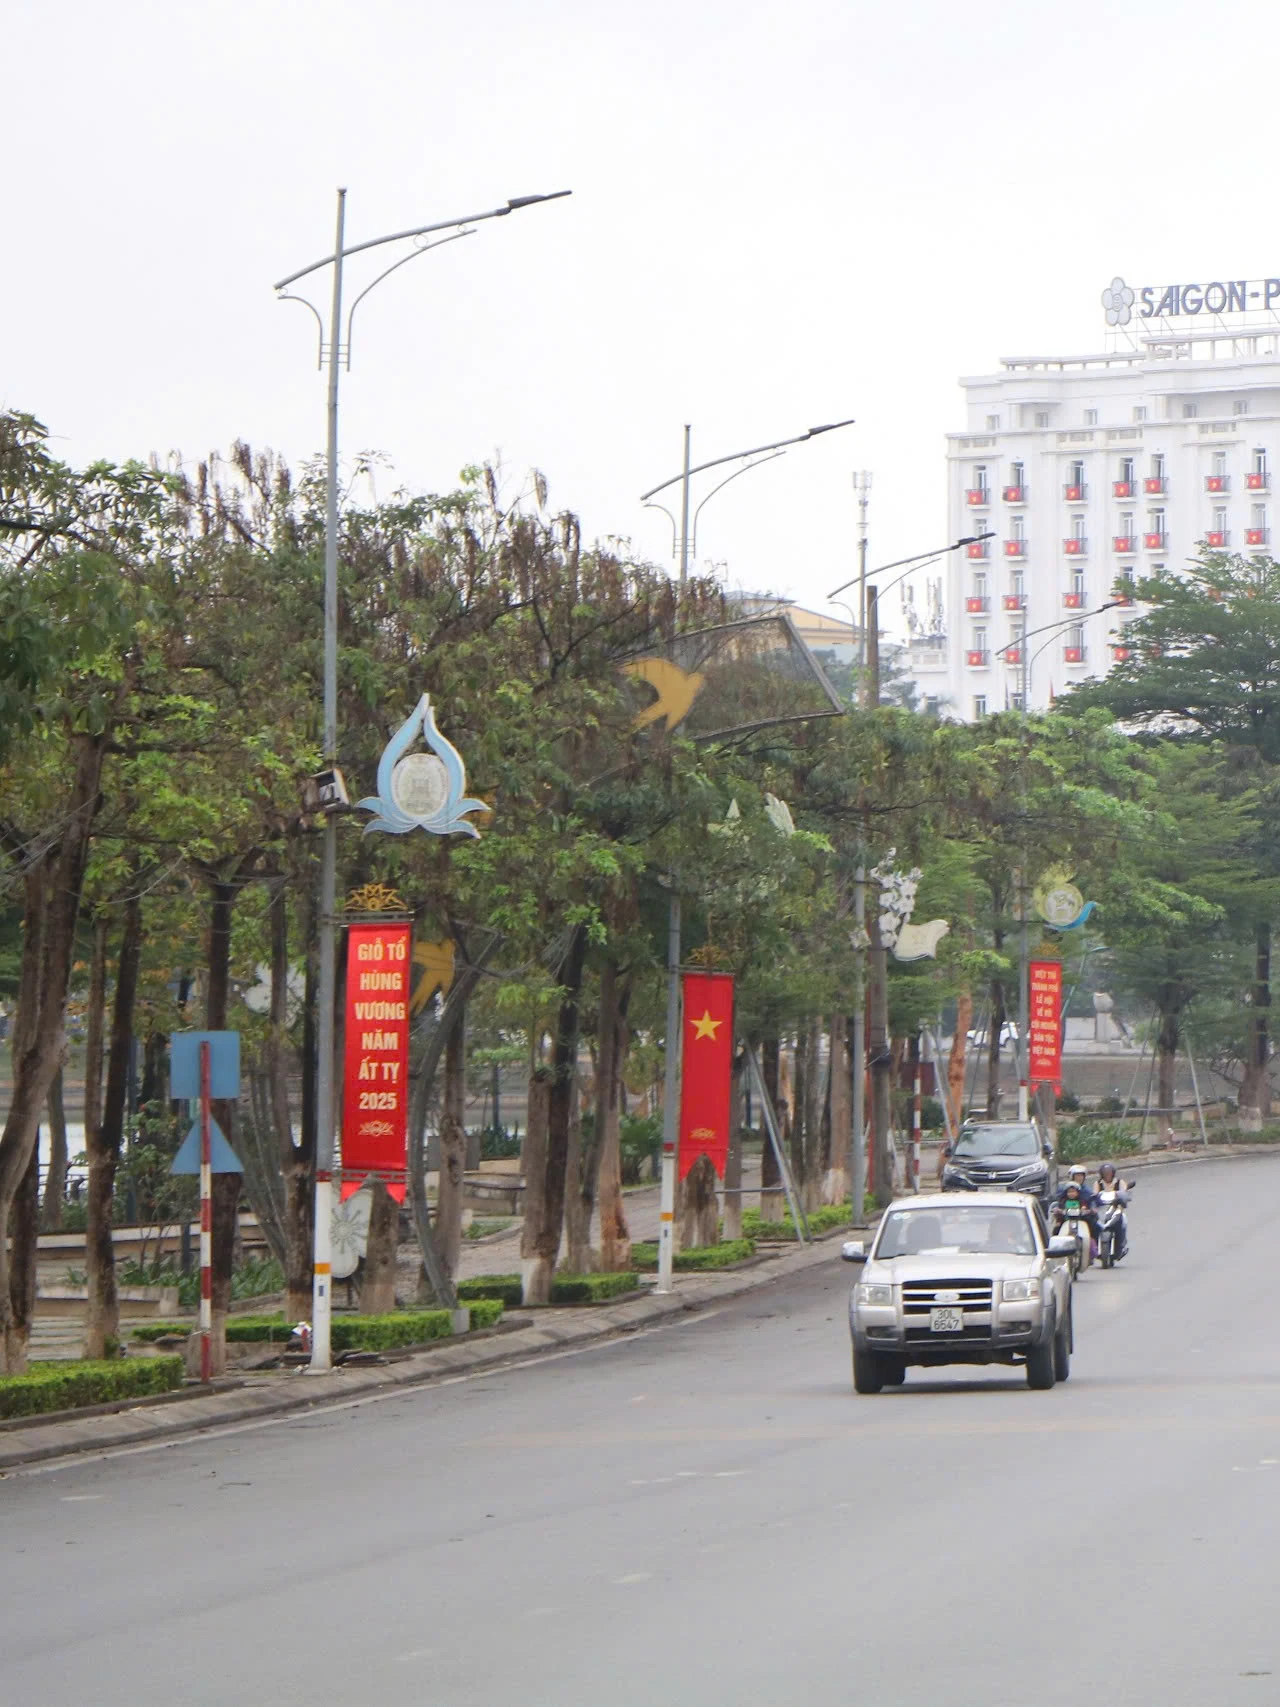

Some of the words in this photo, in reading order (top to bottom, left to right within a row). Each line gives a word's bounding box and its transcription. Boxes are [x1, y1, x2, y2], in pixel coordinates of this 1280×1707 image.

[358, 937, 383, 961] GIỖ
[387, 936, 406, 960] TỔ
[360, 970, 402, 990] HÙNG
[355, 1002, 405, 1020] VƯƠNG
[362, 1030, 398, 1050] NĂM
[359, 1056, 378, 1080] ẤT
[382, 1062, 400, 1084] TỴ
[359, 1092, 397, 1110] 2025
